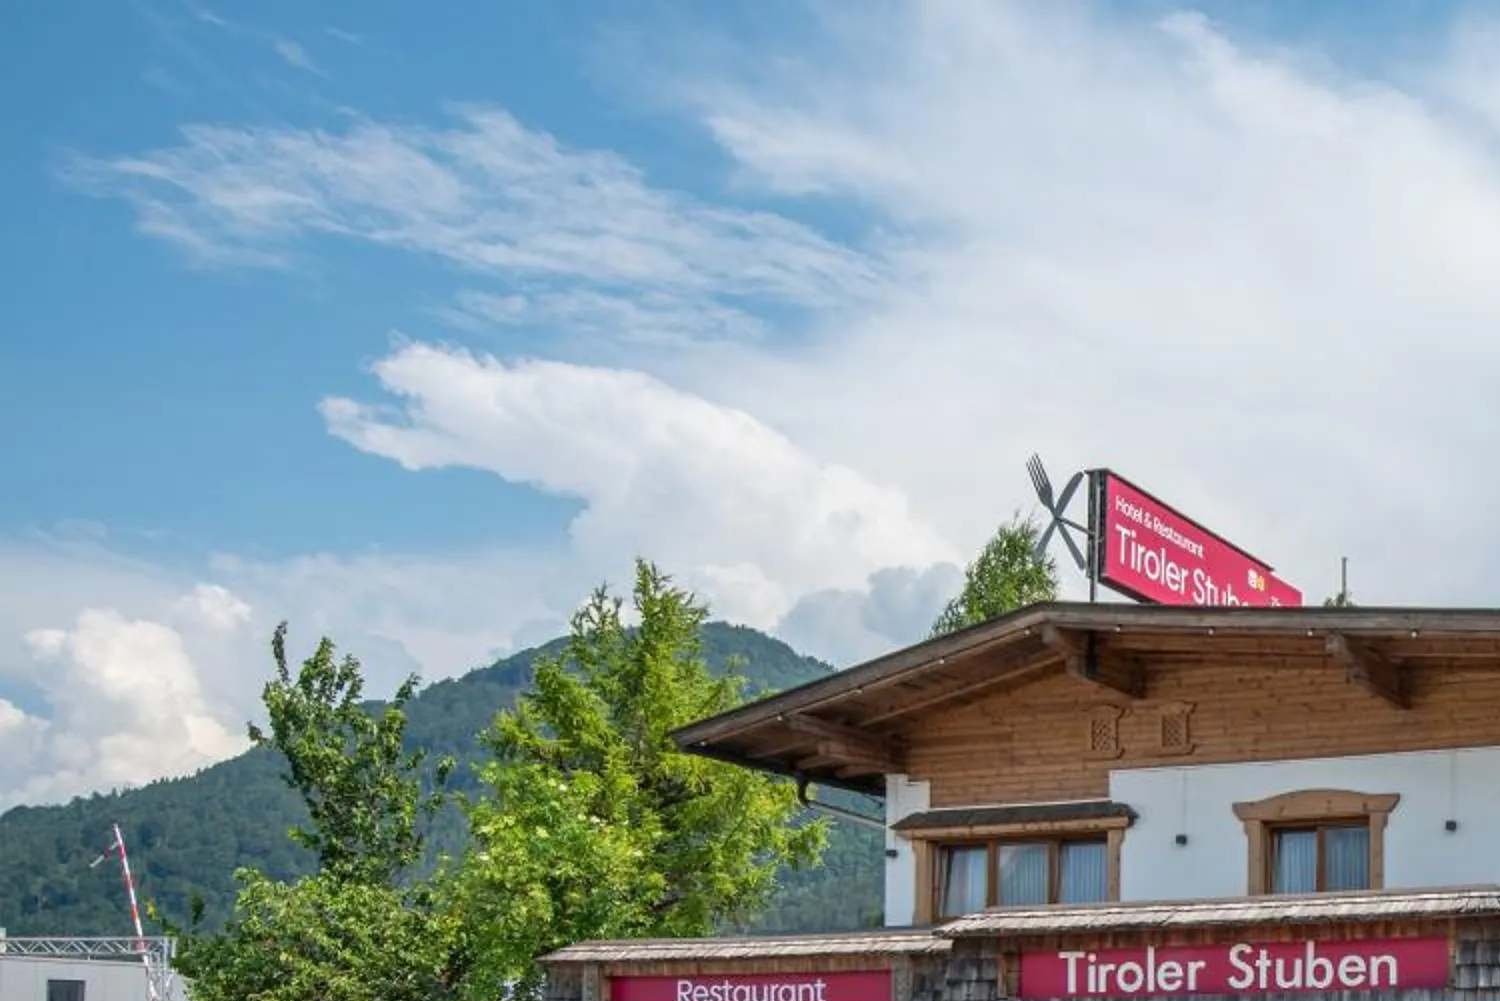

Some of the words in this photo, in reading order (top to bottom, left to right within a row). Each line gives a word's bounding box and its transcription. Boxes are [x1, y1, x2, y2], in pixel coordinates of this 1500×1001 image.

[1115, 495, 1143, 524] Hotel
[1153, 517, 1204, 559] Restaurant
[1115, 522, 1189, 595] Tiroler
[1193, 568, 1250, 607] Stub
[1058, 945, 1206, 994] Tiroler
[1227, 940, 1398, 989] Stuben
